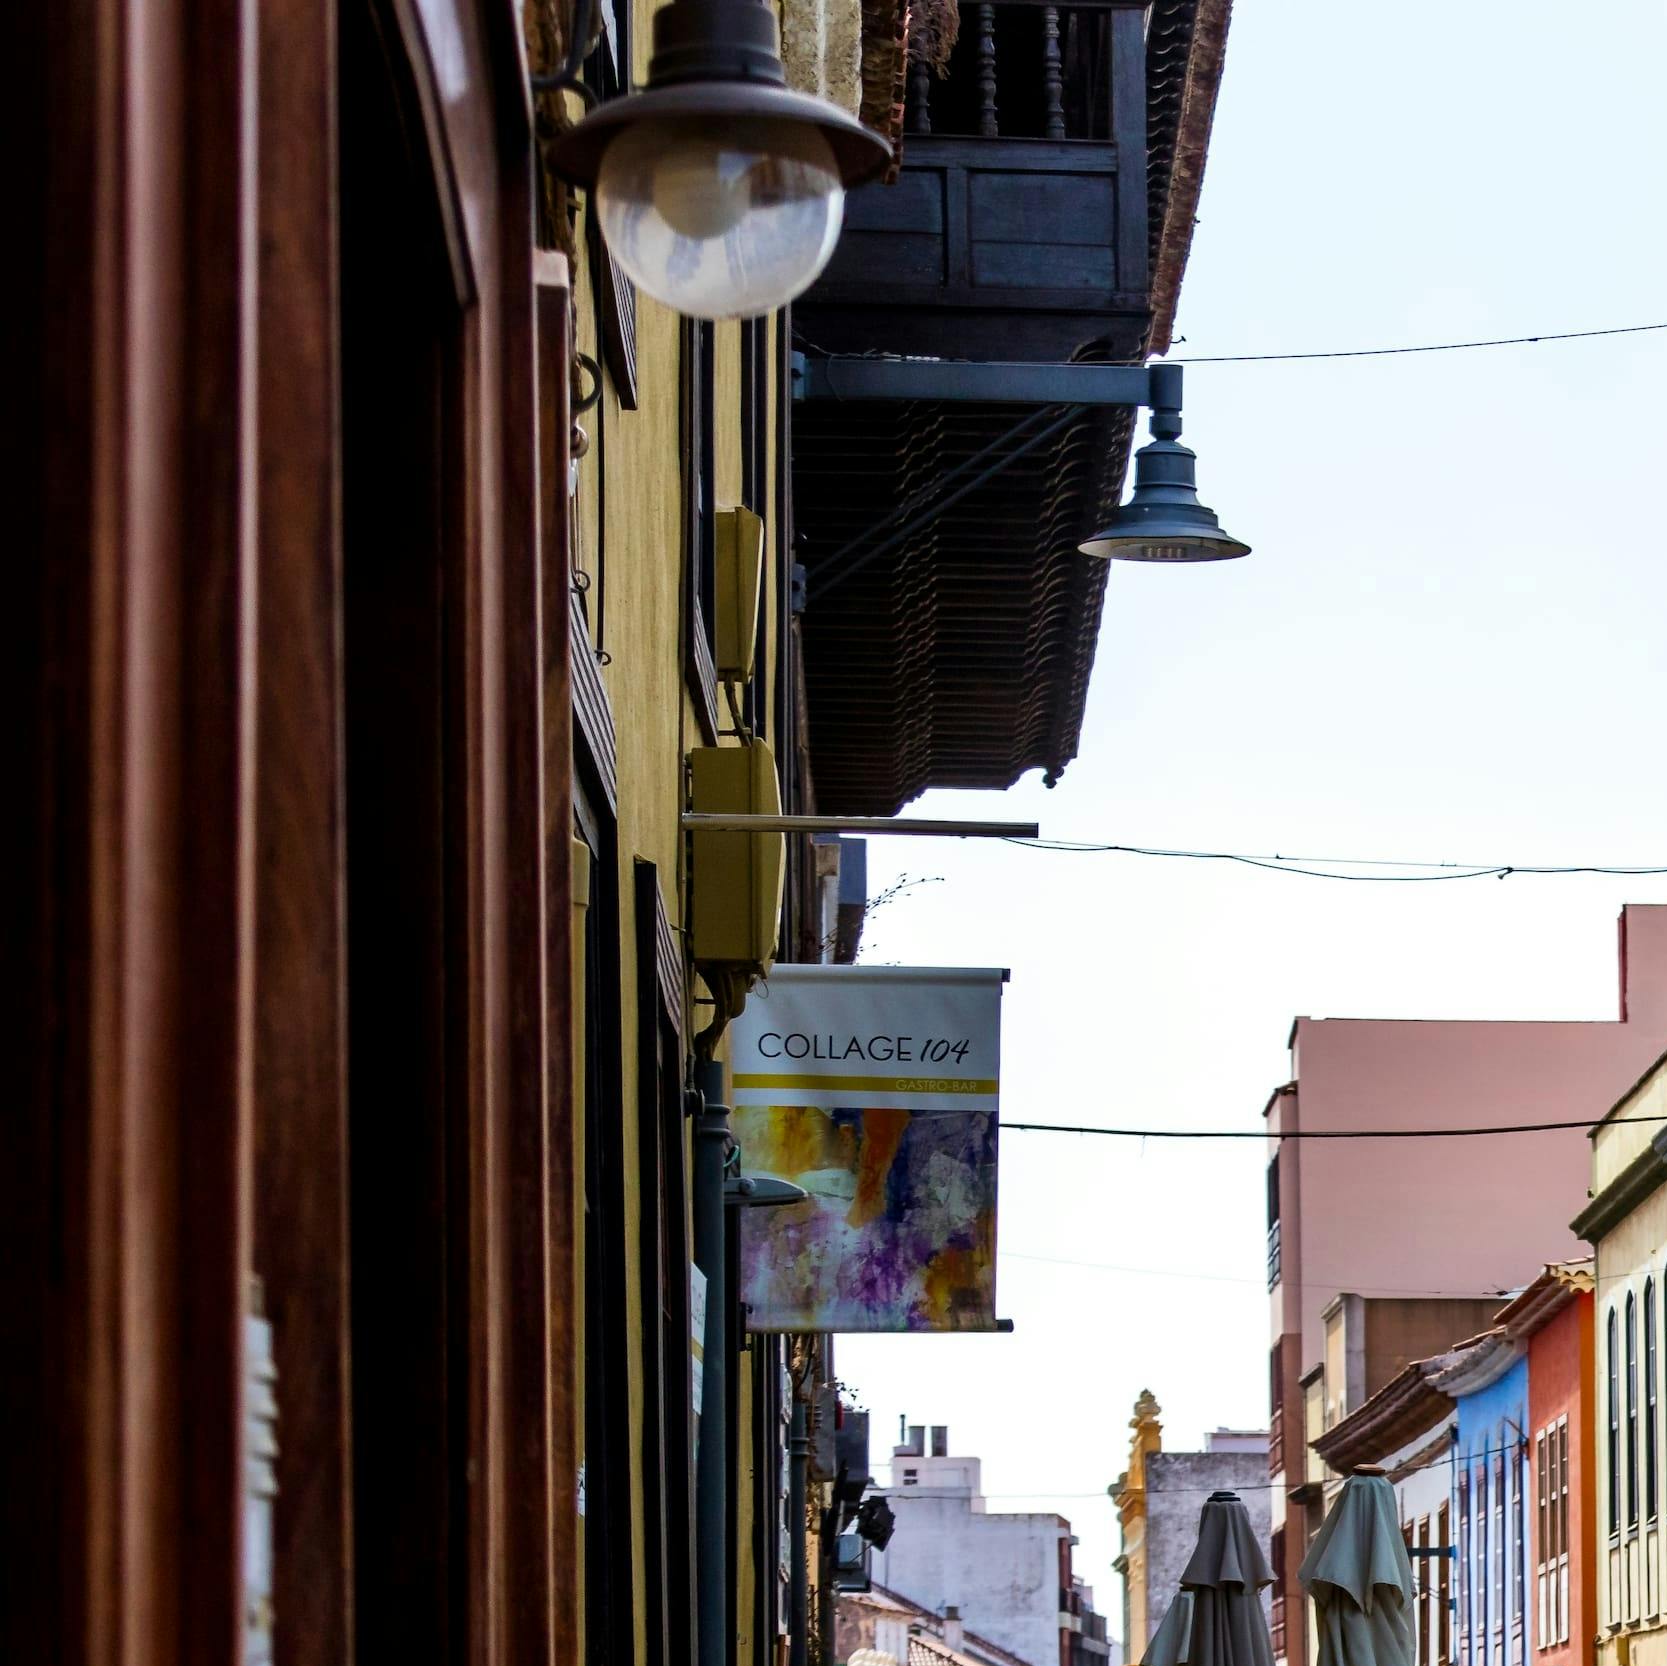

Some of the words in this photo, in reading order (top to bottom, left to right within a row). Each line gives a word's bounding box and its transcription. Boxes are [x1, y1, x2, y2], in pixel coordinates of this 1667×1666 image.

[758, 1032, 913, 1061] COLLAGE
[920, 1038, 970, 1064] 104
[895, 1079, 977, 1092] GASTRO-BAR
